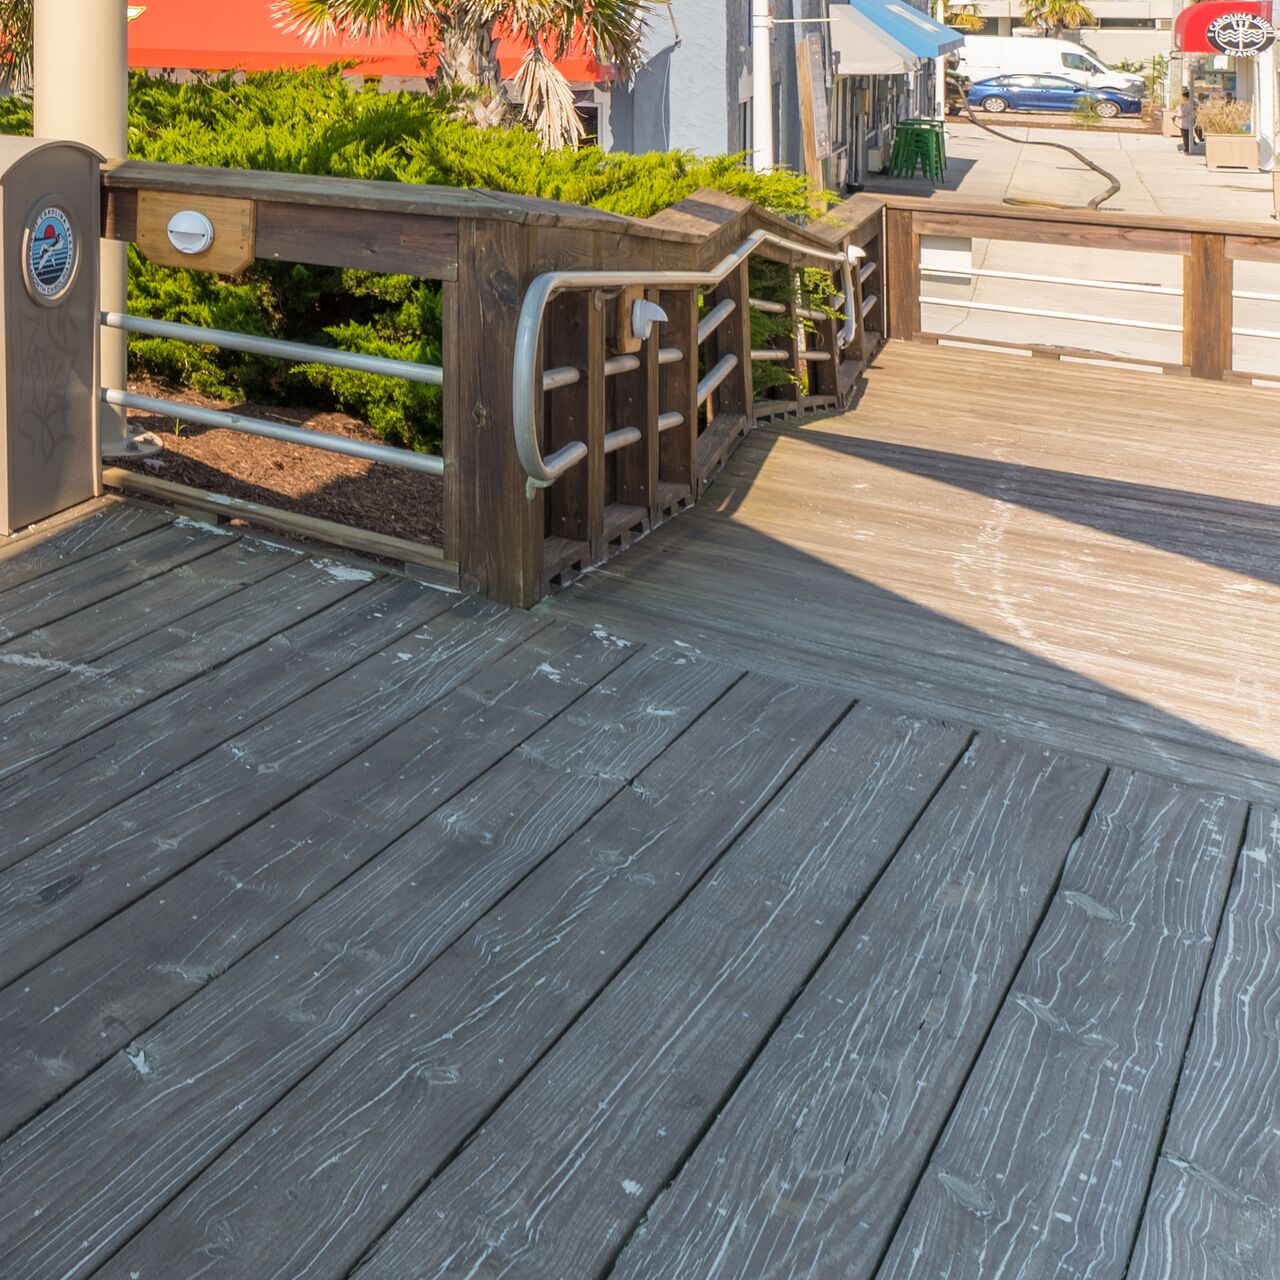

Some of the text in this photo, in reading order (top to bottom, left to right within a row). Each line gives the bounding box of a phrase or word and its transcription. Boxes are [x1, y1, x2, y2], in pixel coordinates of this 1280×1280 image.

[1209, 13, 1252, 31] CAROLINA
[1224, 49, 1258, 58] BRAND
[39, 208, 67, 224] CAROLINA
